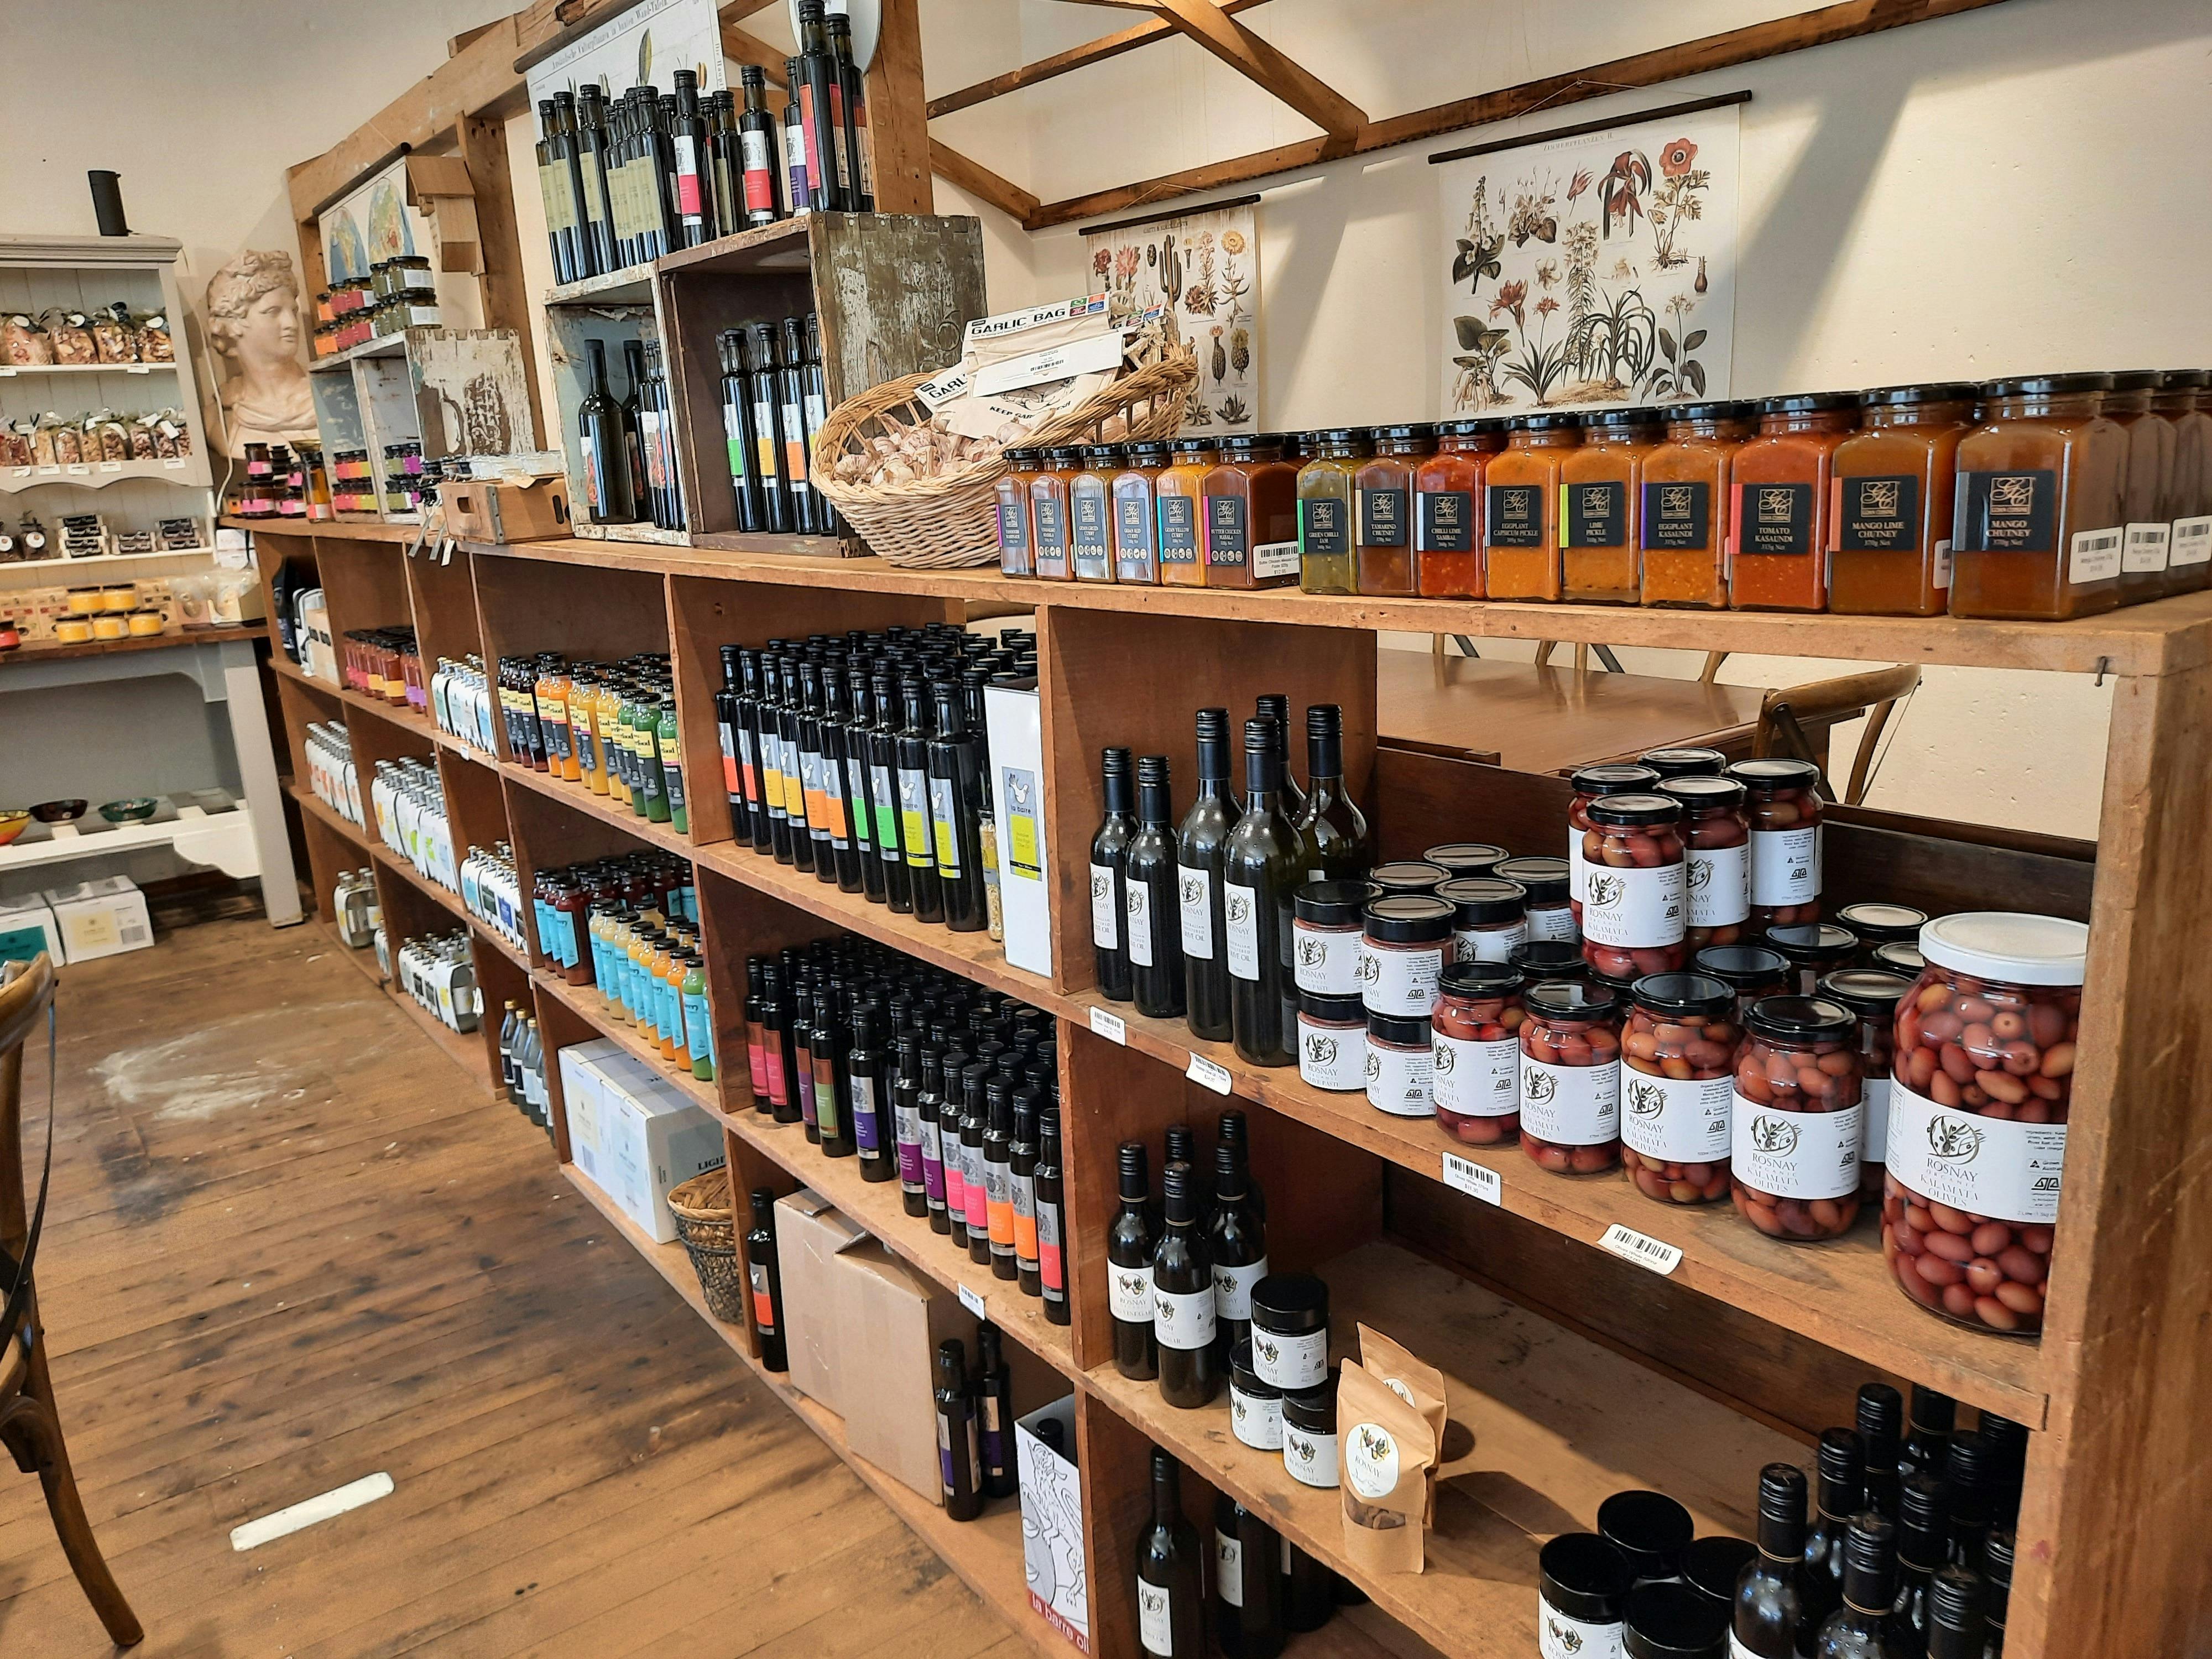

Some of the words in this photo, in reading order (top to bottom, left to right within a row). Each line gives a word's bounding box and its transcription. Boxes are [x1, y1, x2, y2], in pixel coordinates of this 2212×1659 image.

[972, 317, 1027, 335] GARLIC
[1034, 309, 1065, 322] BAG
[928, 373, 968, 398] GARL
[990, 406, 1013, 415] KEEP
[1852, 521, 1882, 530] MANGO
[1991, 520, 2028, 528] MANGO
[1755, 535, 1793, 543] KASAUNDI
[1858, 530, 1898, 538] CHUTNEY
[1985, 529, 2031, 538] CHUTNEY
[1589, 907, 1623, 922] ROSNAY
[1593, 932, 1620, 942] OLIVES
[1300, 969, 1328, 980] ROSNAY
[1308, 1063, 1338, 1076] ROSNAY
[1525, 1099, 1555, 1118] ROSNAY
[1629, 1114, 1664, 1133] ROSNAY
[1631, 1139, 1658, 1154] OLIVES
[698, 1155, 725, 1170] LIGH
[1752, 1152, 1798, 1171] ROSNAY
[1747, 1166, 1799, 1186] KALAMATA
[1927, 1158, 1978, 1182] ROSNAY
[1754, 1178, 1788, 1192] OLIVES
[1921, 1174, 1978, 1200] KALAMATA
[1928, 1188, 1967, 1206] OLIVES
[1032, 1592, 1042, 1614] la
[1045, 1603, 1073, 1641] barre
[1077, 1635, 1089, 1655] oil
